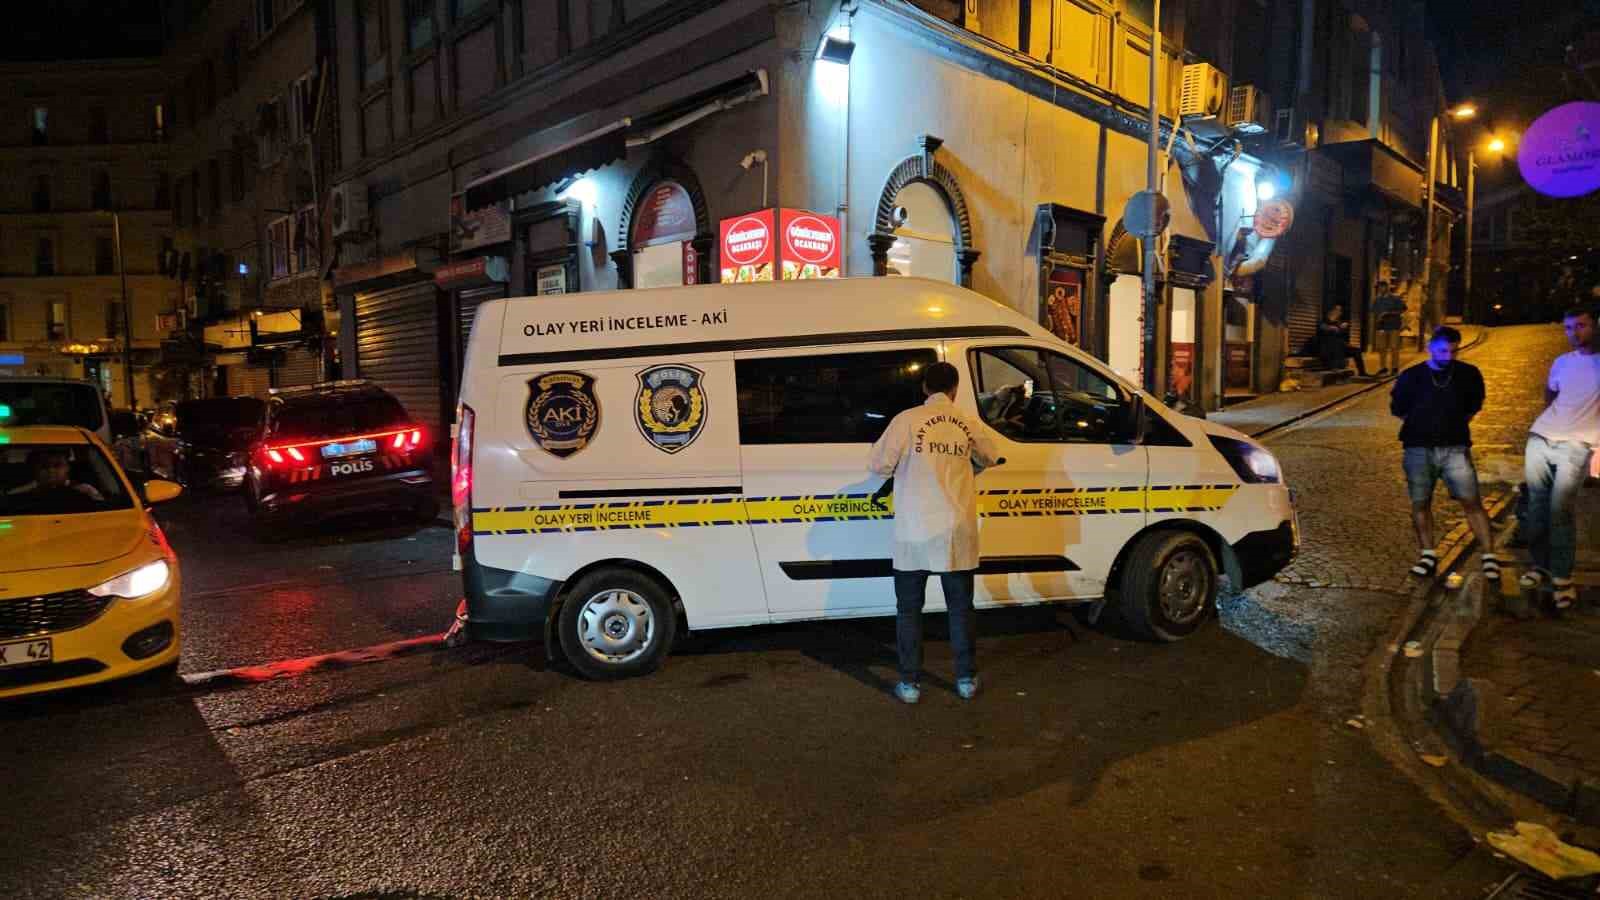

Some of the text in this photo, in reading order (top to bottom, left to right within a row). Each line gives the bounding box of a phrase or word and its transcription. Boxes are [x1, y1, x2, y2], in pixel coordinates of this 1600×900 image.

[523, 322, 565, 337] OLAY
[569, 316, 604, 334] YERİ
[608, 313, 689, 331] İNCELEME
[701, 308, 728, 325] AKİ
[543, 404, 582, 422] AKİ
[792, 503, 824, 514] OLAY
[999, 498, 1029, 509] OLAY
[534, 514, 566, 525] OLAY
[27, 642, 49, 658] 42
